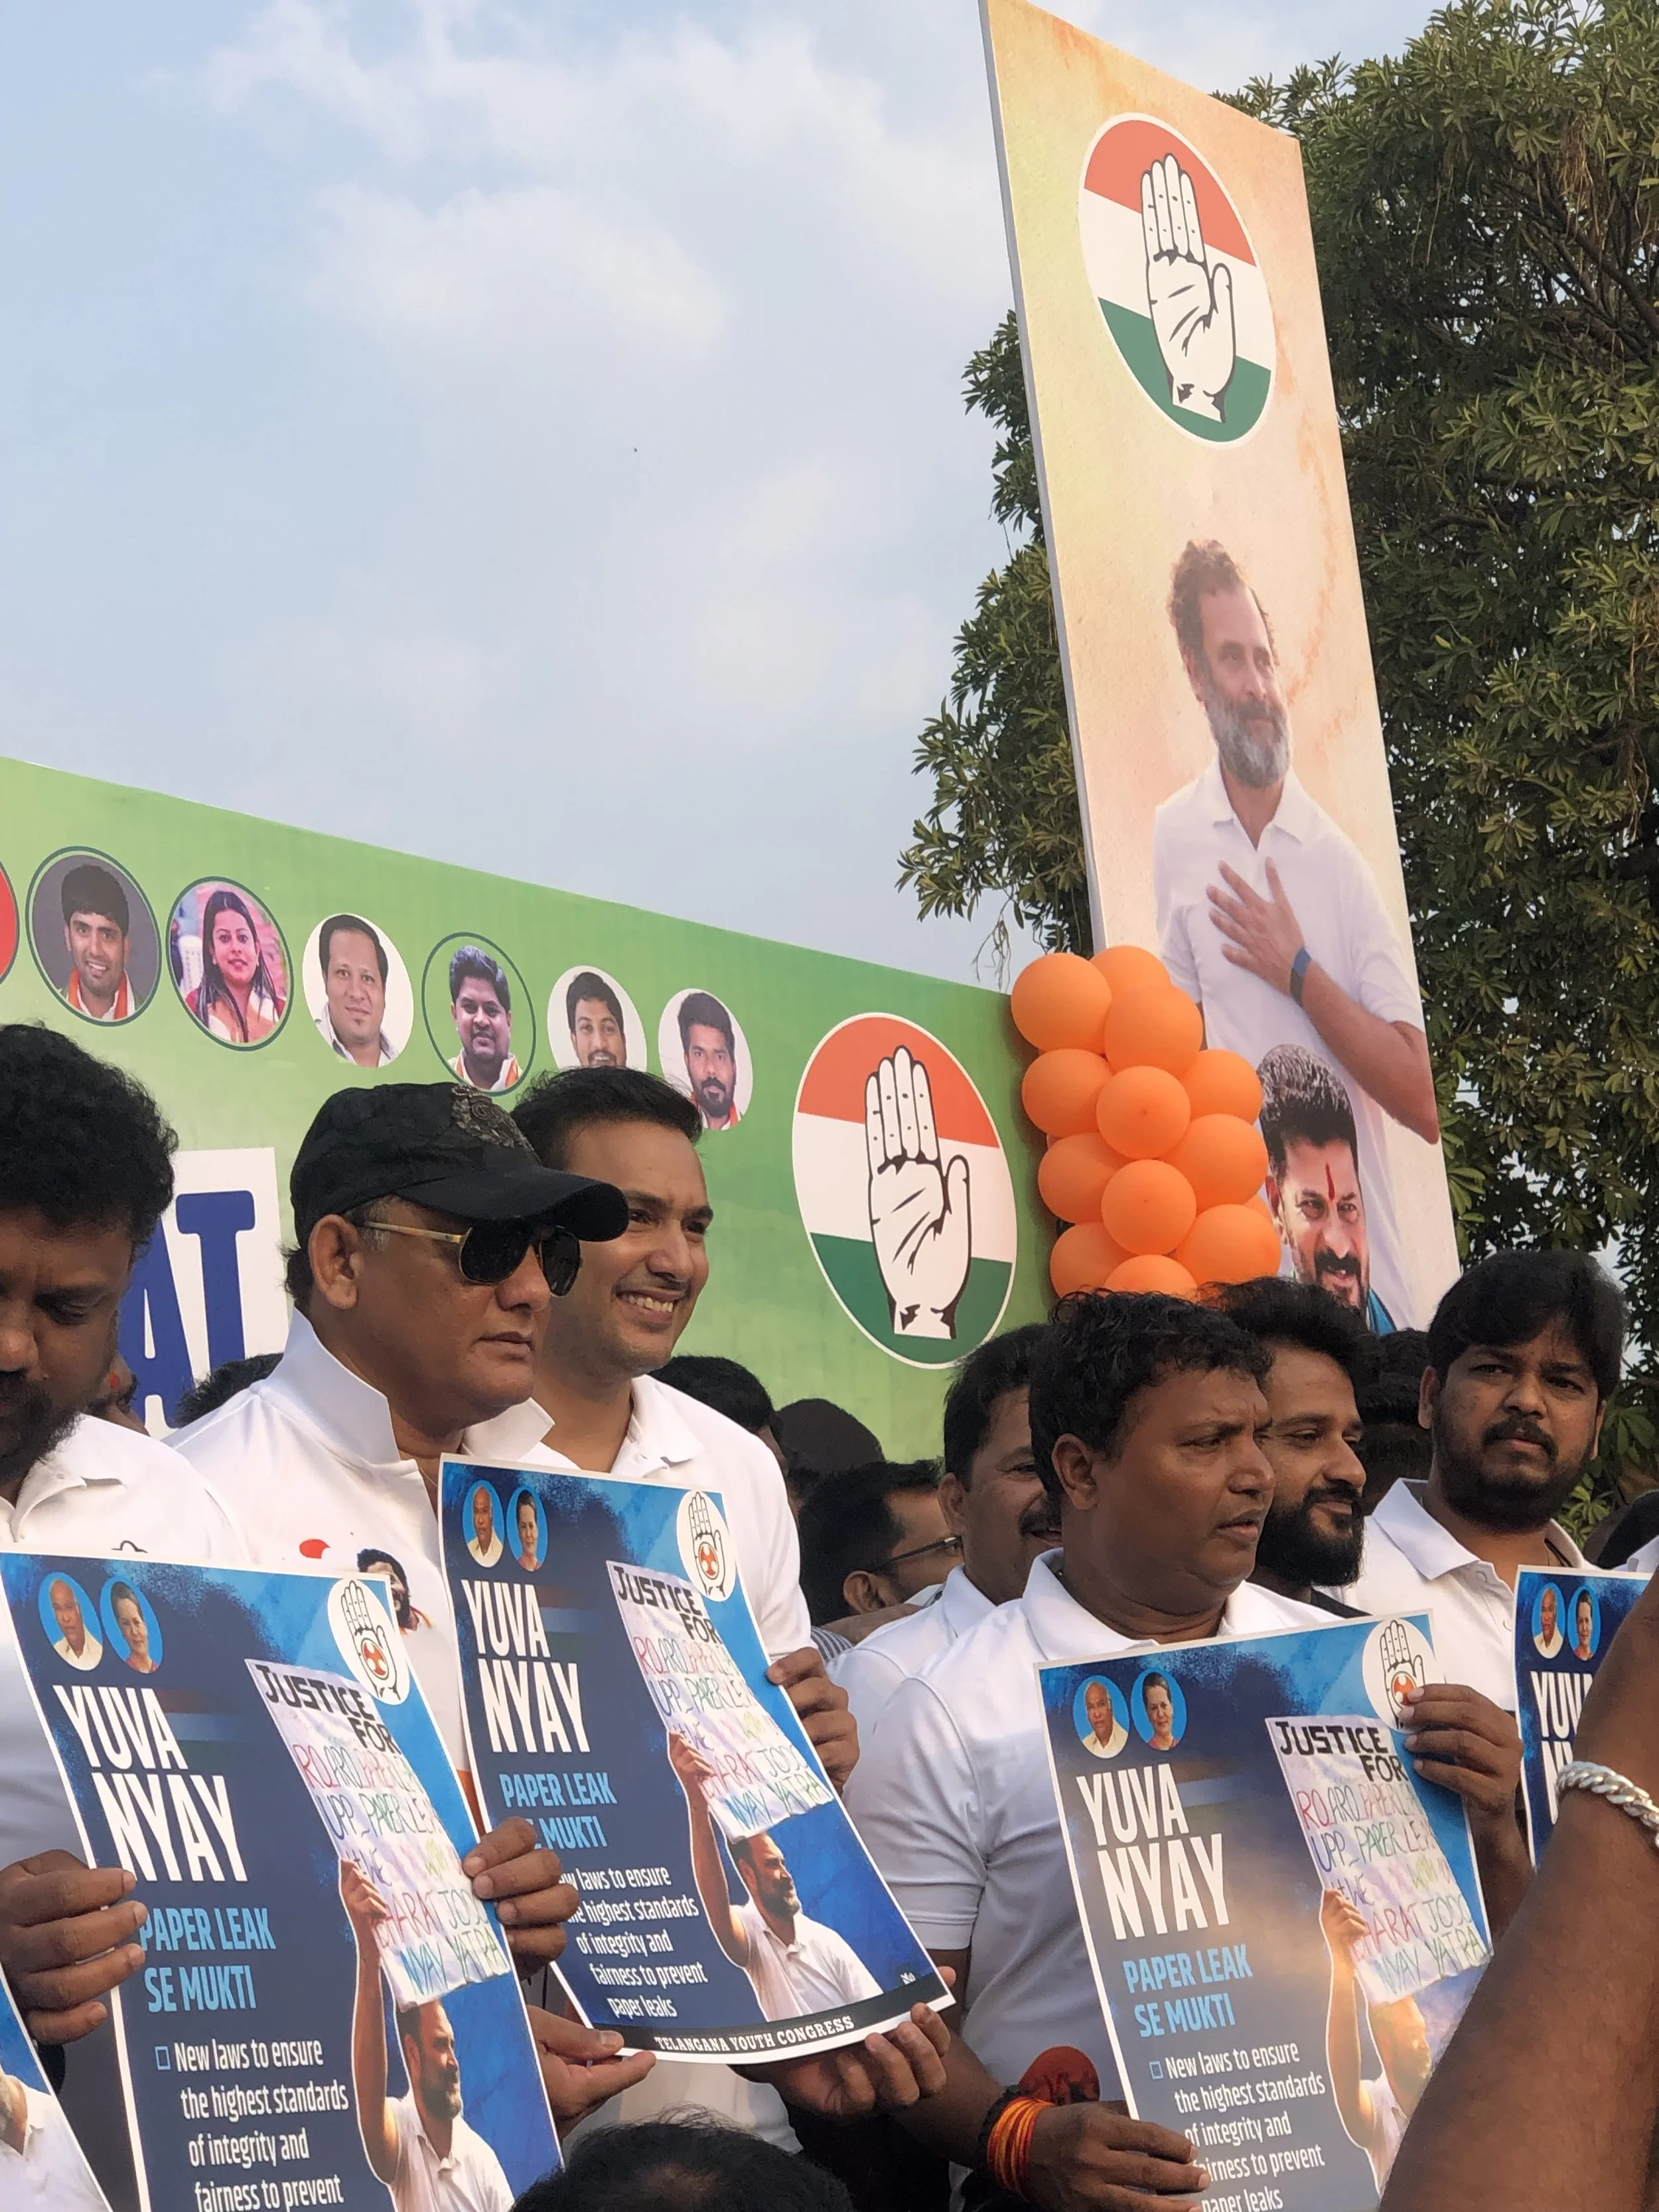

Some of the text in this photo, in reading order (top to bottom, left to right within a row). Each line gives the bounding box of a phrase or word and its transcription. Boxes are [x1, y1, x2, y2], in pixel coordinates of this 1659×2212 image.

[614, 1565, 704, 1617] JUSTICE
[461, 1580, 551, 1658] YUVA
[680, 1613, 723, 1645] FOR
[255, 1664, 376, 1721] JUSTICE
[478, 1659, 591, 1753] NYAY
[1530, 1670, 1593, 1738] YUV
[52, 1684, 188, 1770] YUVA
[348, 1717, 401, 1755] FOR
[1275, 1720, 1390, 1756] JUSTICE
[1360, 1754, 1407, 1783] FOR
[500, 1772, 617, 1808] PAPER LEAK
[1076, 1763, 1189, 1846] YUVA
[92, 1773, 248, 1881] NYAY
[539, 1815, 608, 1850] MUKTI
[575, 1868, 611, 1890] laws
[609, 1868, 626, 1889] to
[627, 1866, 672, 1888] ensure
[1097, 1833, 1230, 1940] NYAY
[139, 1907, 276, 1951] PAPER LEAK
[582, 1898, 634, 1926] highest
[634, 1894, 699, 1917] standards
[576, 1929, 674, 1958] of integrity and
[589, 1961, 708, 1989] fairness to prevent
[1123, 1944, 1253, 1994] PAPER LEAK
[144, 1965, 257, 2012] SE MUKTI
[607, 1995, 678, 2019] paper leaks
[654, 2015, 855, 2051] TELANGANA YOUTH CONGRESS
[1134, 1993, 1236, 2037] SE MUKTI
[174, 2038, 324, 2072] New laws to ensure
[1165, 2042, 1301, 2079] New laws to ensure
[180, 2079, 349, 2122] the highest standards
[1174, 2071, 1326, 2114] the highest standards
[188, 2127, 310, 2169] of integrity and
[1185, 2110, 1292, 2148] of integrity and
[1251, 2153, 1267, 2176] to
[1269, 2144, 1325, 2177] prevent
[195, 2174, 344, 2212] fairness to prevent
[1243, 2185, 1283, 2212] leaks
